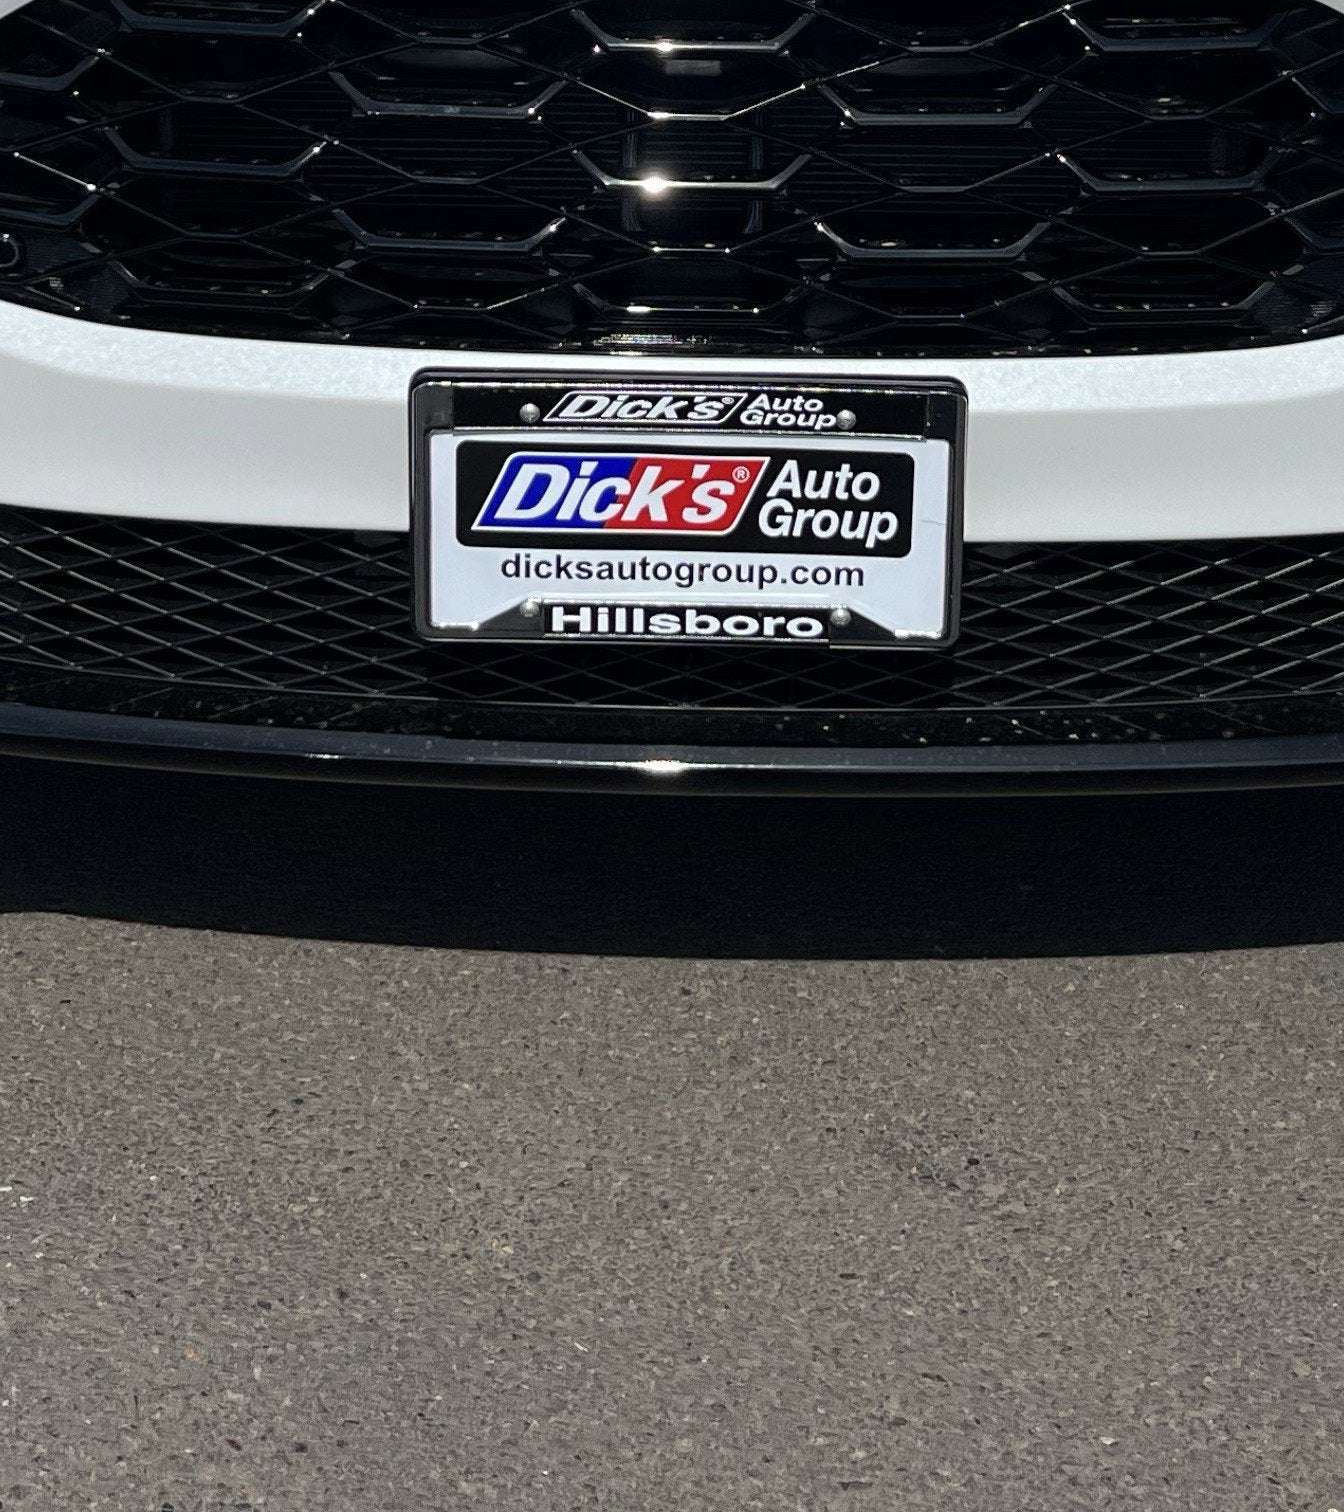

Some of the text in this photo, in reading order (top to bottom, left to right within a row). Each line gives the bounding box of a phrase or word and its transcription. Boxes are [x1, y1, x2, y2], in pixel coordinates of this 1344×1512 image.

[747, 393, 824, 412] Auto
[740, 410, 836, 430] Group
[767, 459, 881, 501] Auto
[758, 499, 899, 548] Group
[501, 554, 865, 588] dicksautogroup.com
[550, 605, 824, 638] Hillsboro
